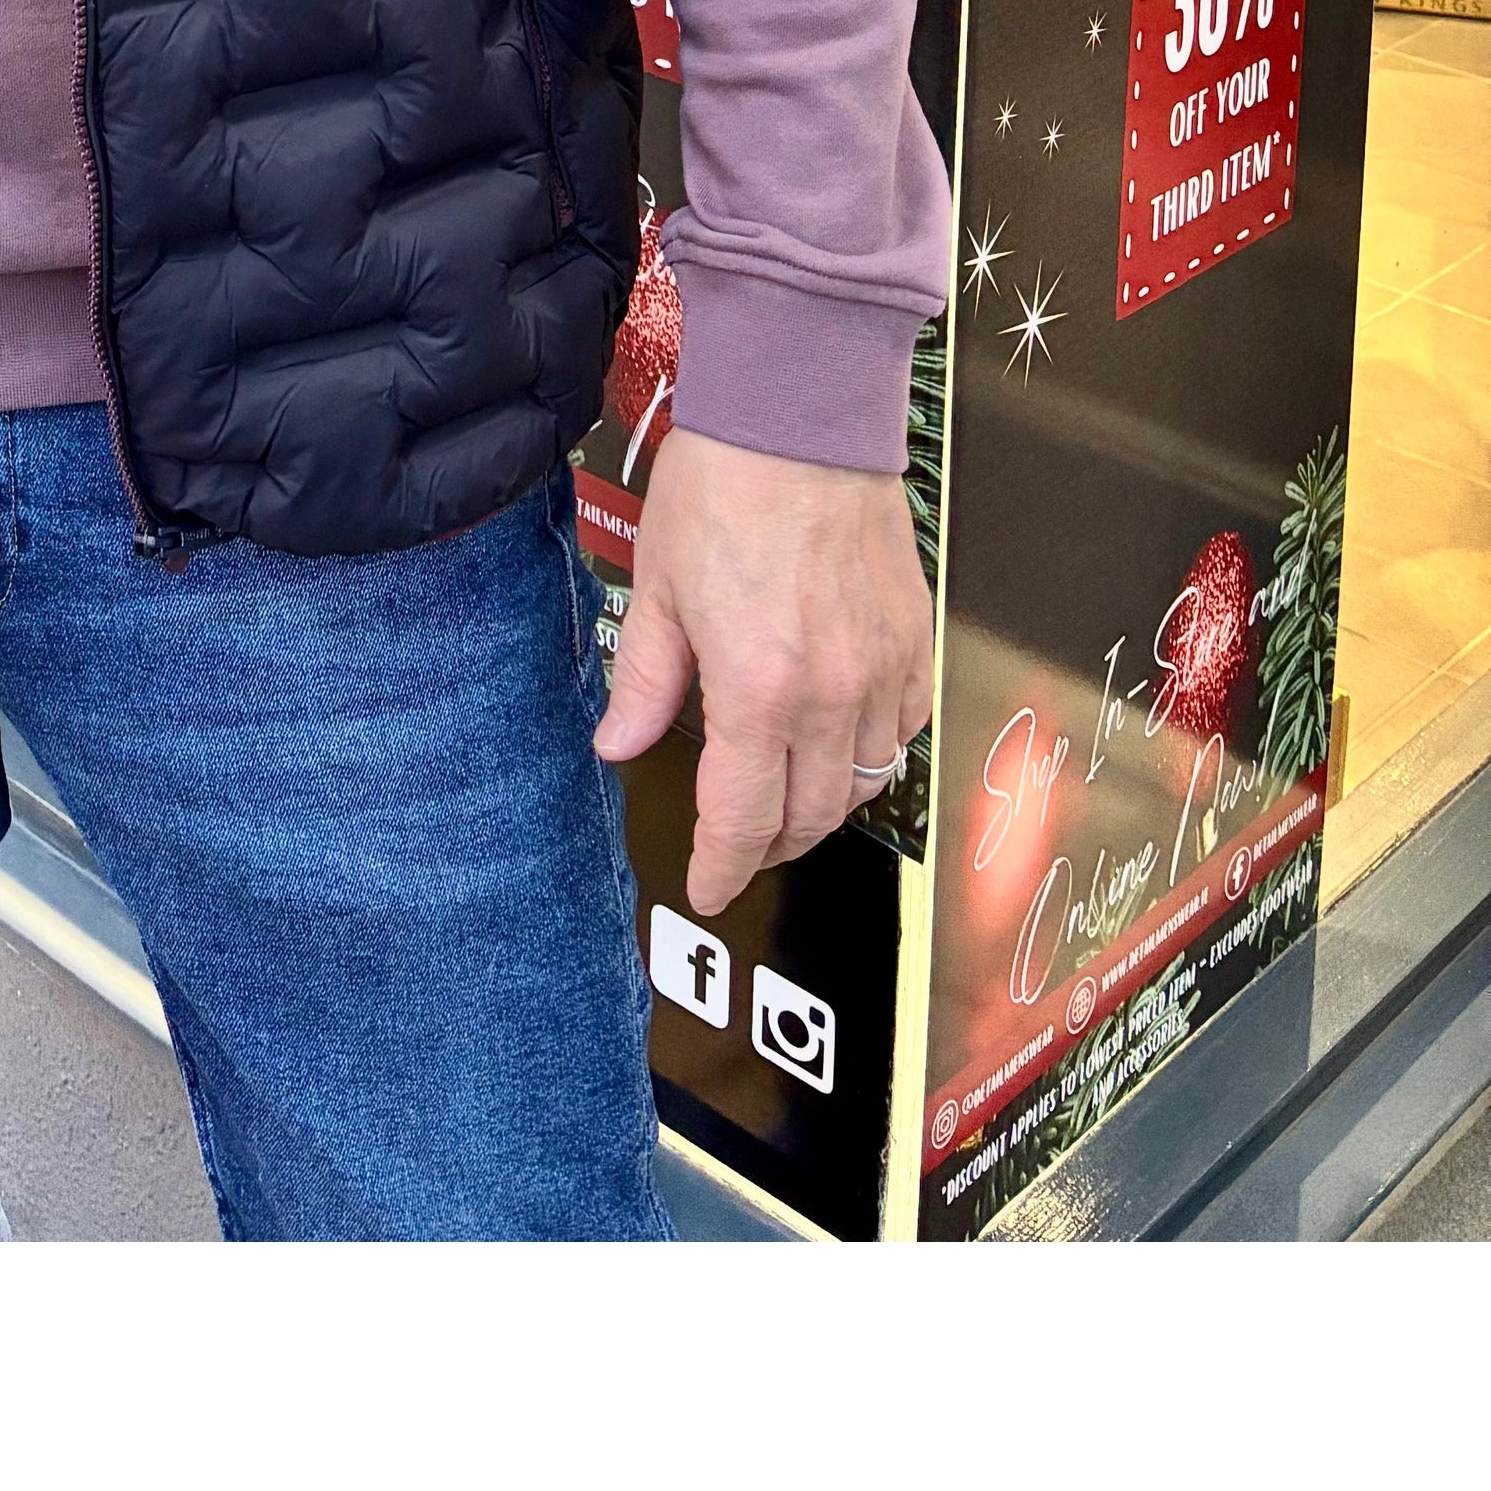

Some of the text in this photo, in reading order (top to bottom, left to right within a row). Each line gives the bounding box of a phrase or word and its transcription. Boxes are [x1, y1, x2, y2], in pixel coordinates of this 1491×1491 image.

[1169, 57, 1271, 149] OFF YOUR
[1150, 168, 1214, 242] THIRD
[973, 707, 1070, 872] Shop
[961, 1024, 1055, 1115] @DETAILMENSWEAR
[1252, 793, 1318, 863] DETAILMENSWEAR
[1010, 1088, 1058, 1149] APPLIES
[1059, 1072, 1077, 1104] TO
[1079, 1025, 1126, 1086] LOWEST
[1127, 990, 1167, 1042] PRICED
[1168, 962, 1197, 1006] ITEM
[1209, 907, 1259, 968] EXCLUDES
[1259, 859, 1314, 924] FOOTWEAR
[1091, 1007, 1185, 1110] AND ACCESSORIES
